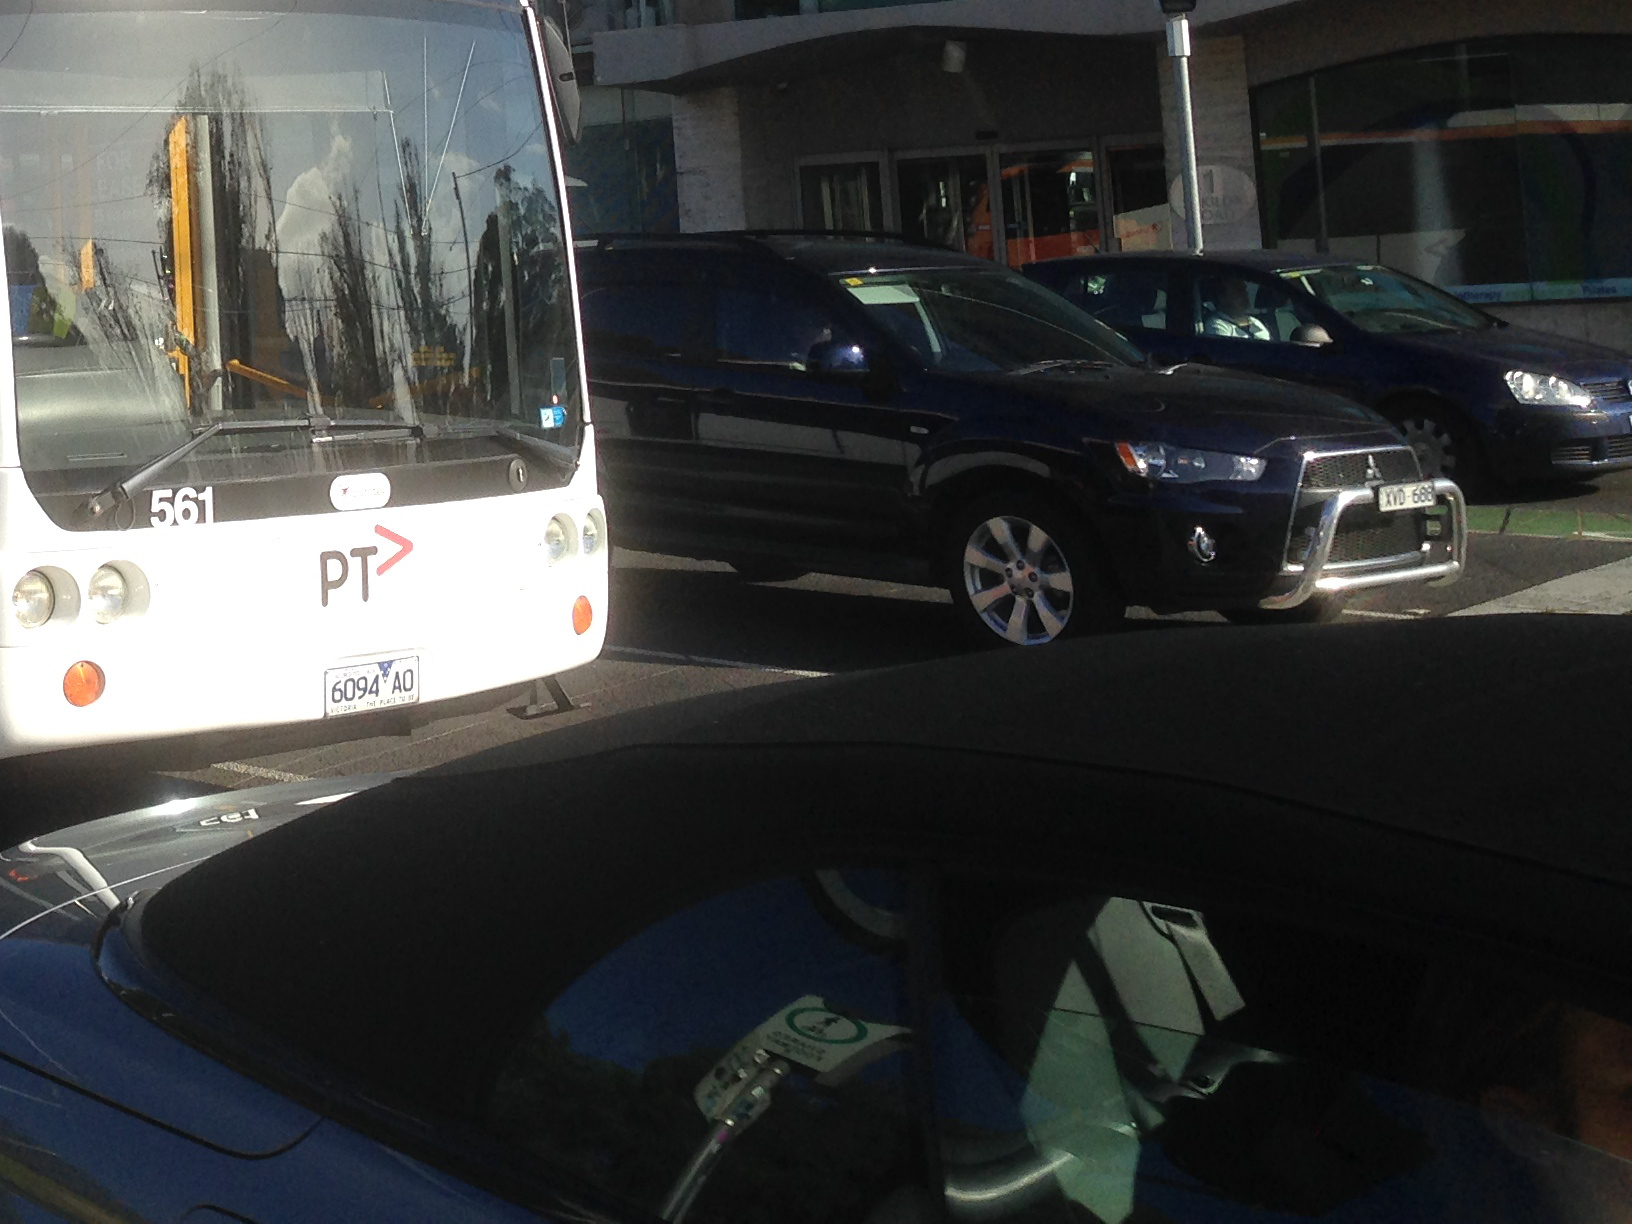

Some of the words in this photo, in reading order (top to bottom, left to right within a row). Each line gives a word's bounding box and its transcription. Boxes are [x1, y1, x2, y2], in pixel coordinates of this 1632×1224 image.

[149, 485, 215, 529] 561
[331, 673, 380, 704] 6094
[391, 668, 414, 695] AO
